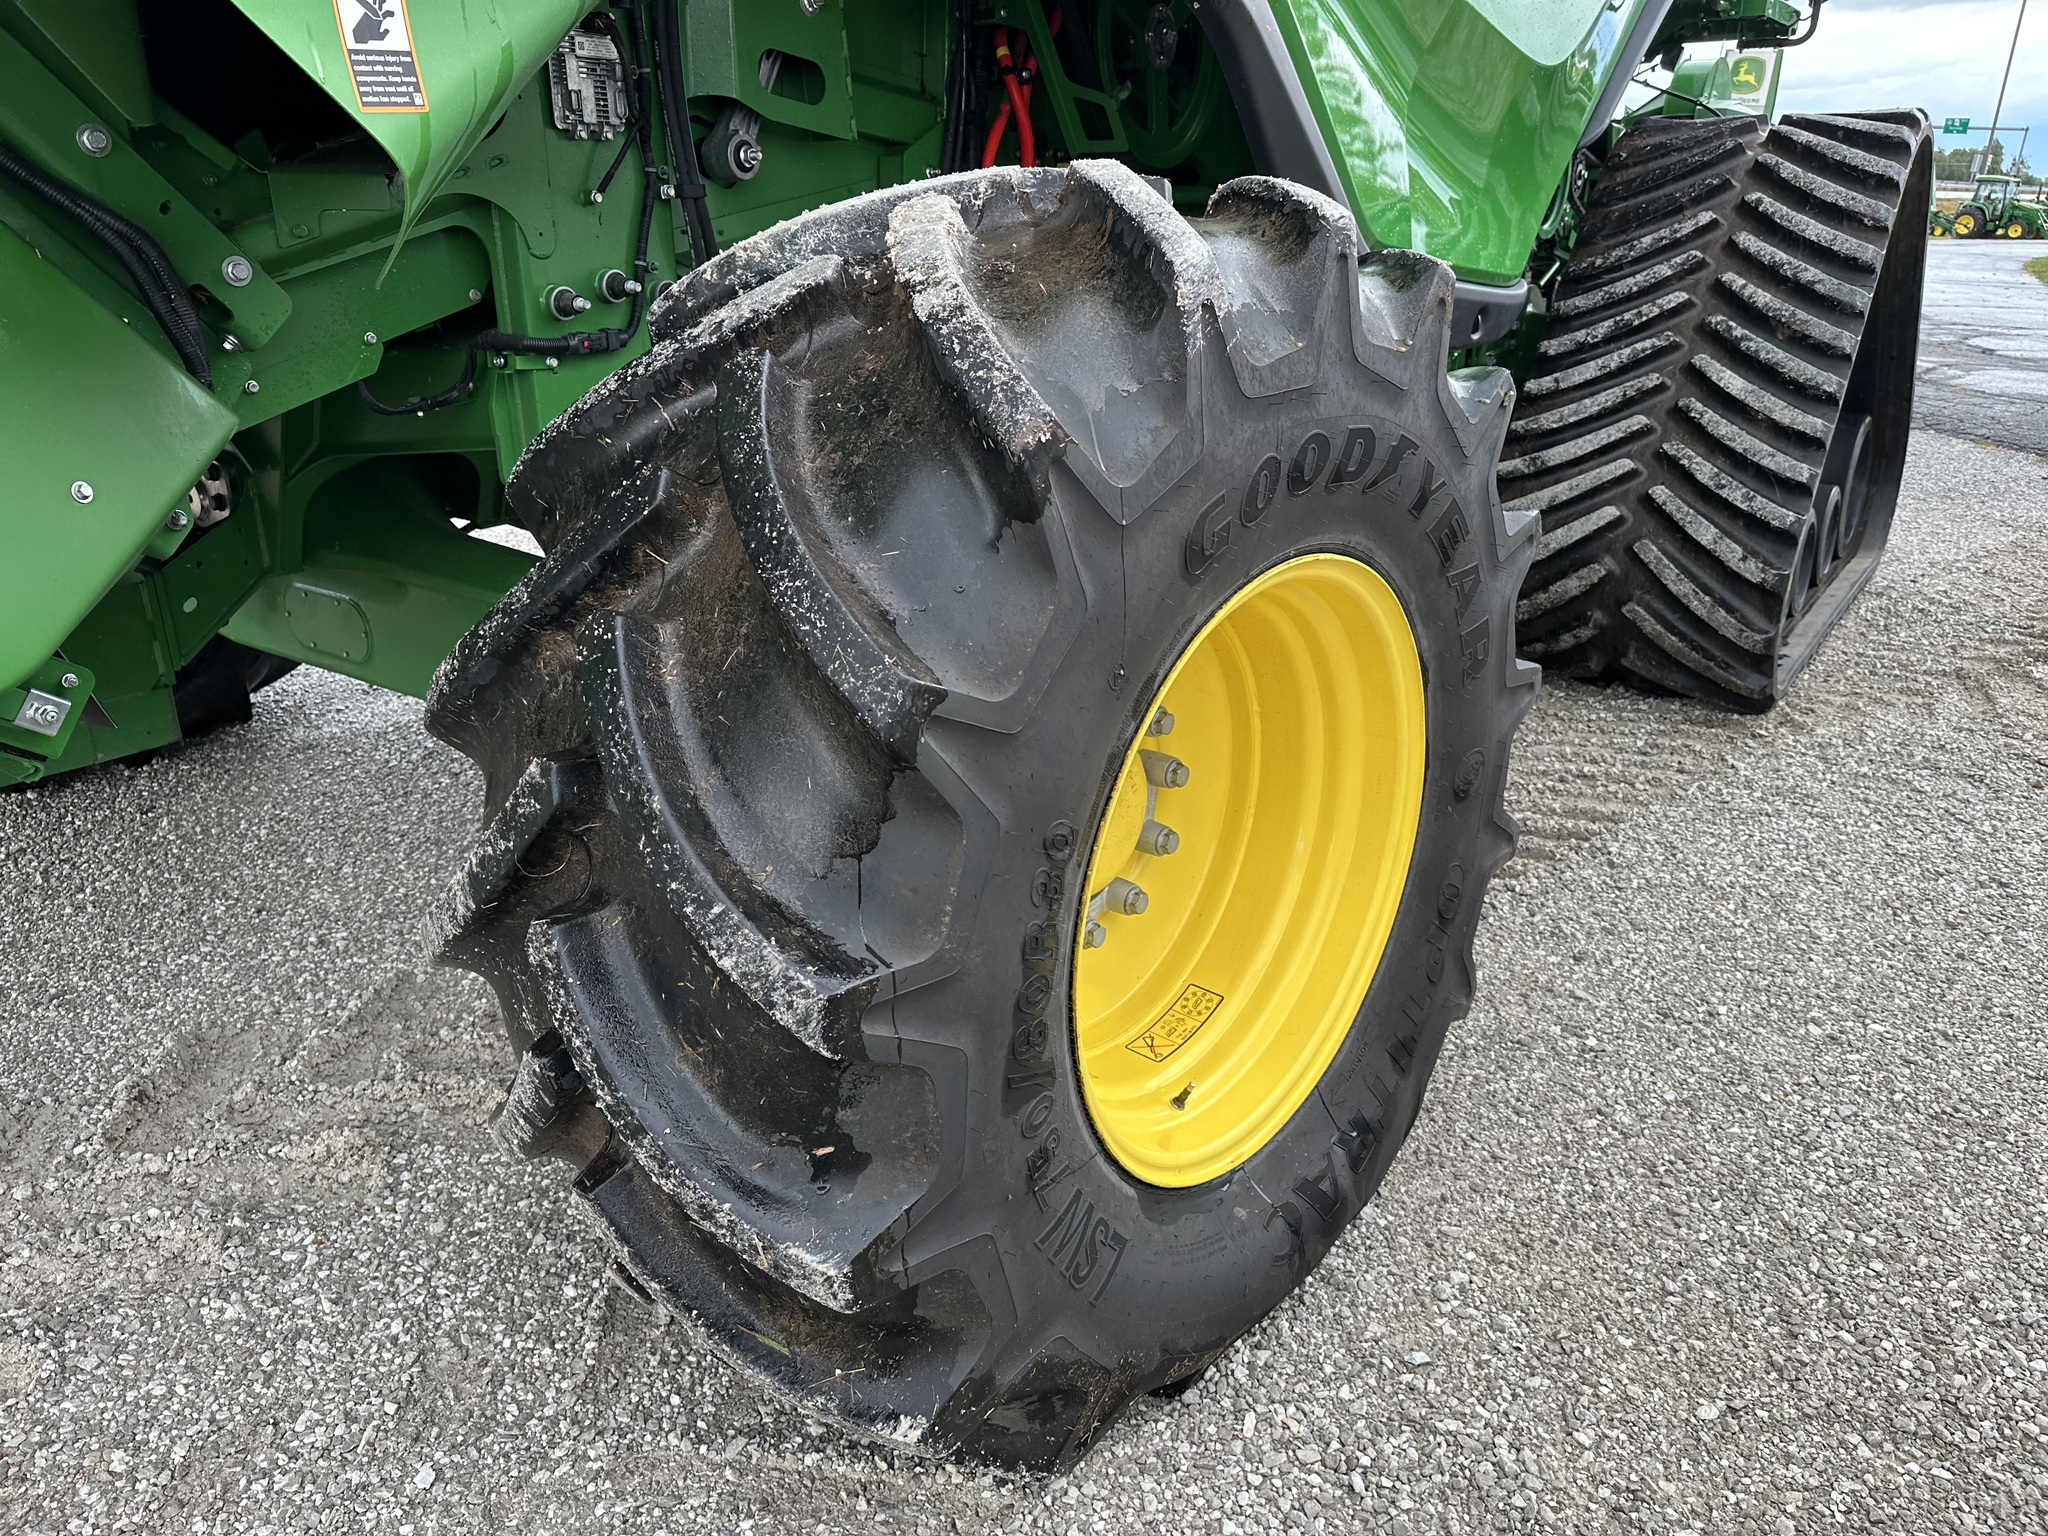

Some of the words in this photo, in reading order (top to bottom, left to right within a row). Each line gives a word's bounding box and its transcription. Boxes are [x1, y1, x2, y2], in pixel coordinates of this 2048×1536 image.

[356, 75, 388, 83] components.
[388, 75, 401, 83] Keep
[384, 65, 403, 73] moving
[385, 54, 400, 63] injury
[1186, 425, 1489, 687] GOODYEAR
[1008, 819, 1078, 1212] 750/60R30
[1264, 863, 1464, 1266] OPTITRAC
[1345, 1041, 1370, 1083] ROTATION
[1034, 1188, 1131, 1307] LSW
